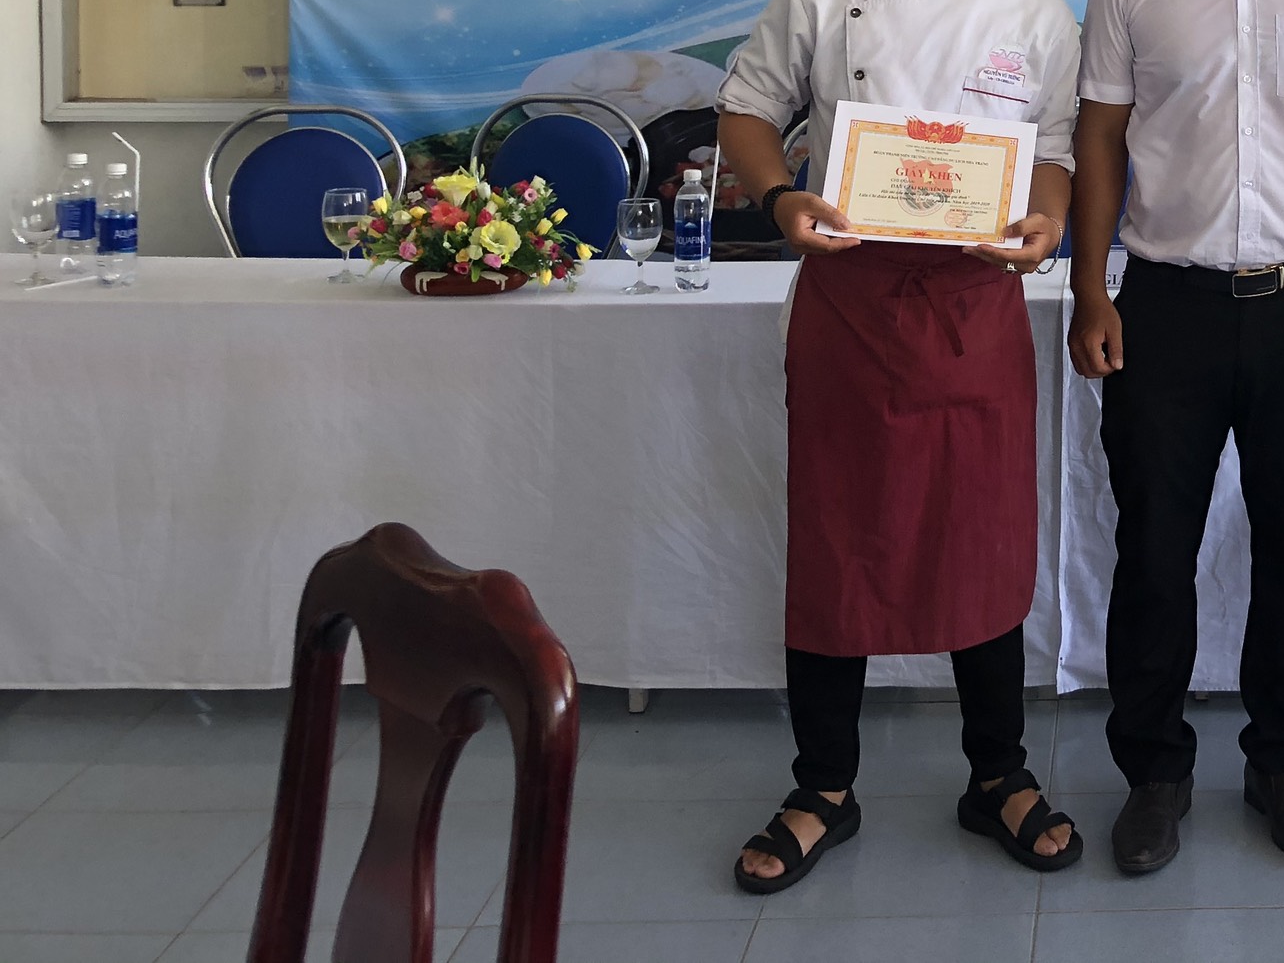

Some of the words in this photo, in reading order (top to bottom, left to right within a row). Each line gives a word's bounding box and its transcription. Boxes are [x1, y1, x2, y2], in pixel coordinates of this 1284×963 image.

[895, 164, 925, 178] GIẤY
[929, 170, 963, 182] KHEN
[675, 235, 707, 245] AQUAFINA
